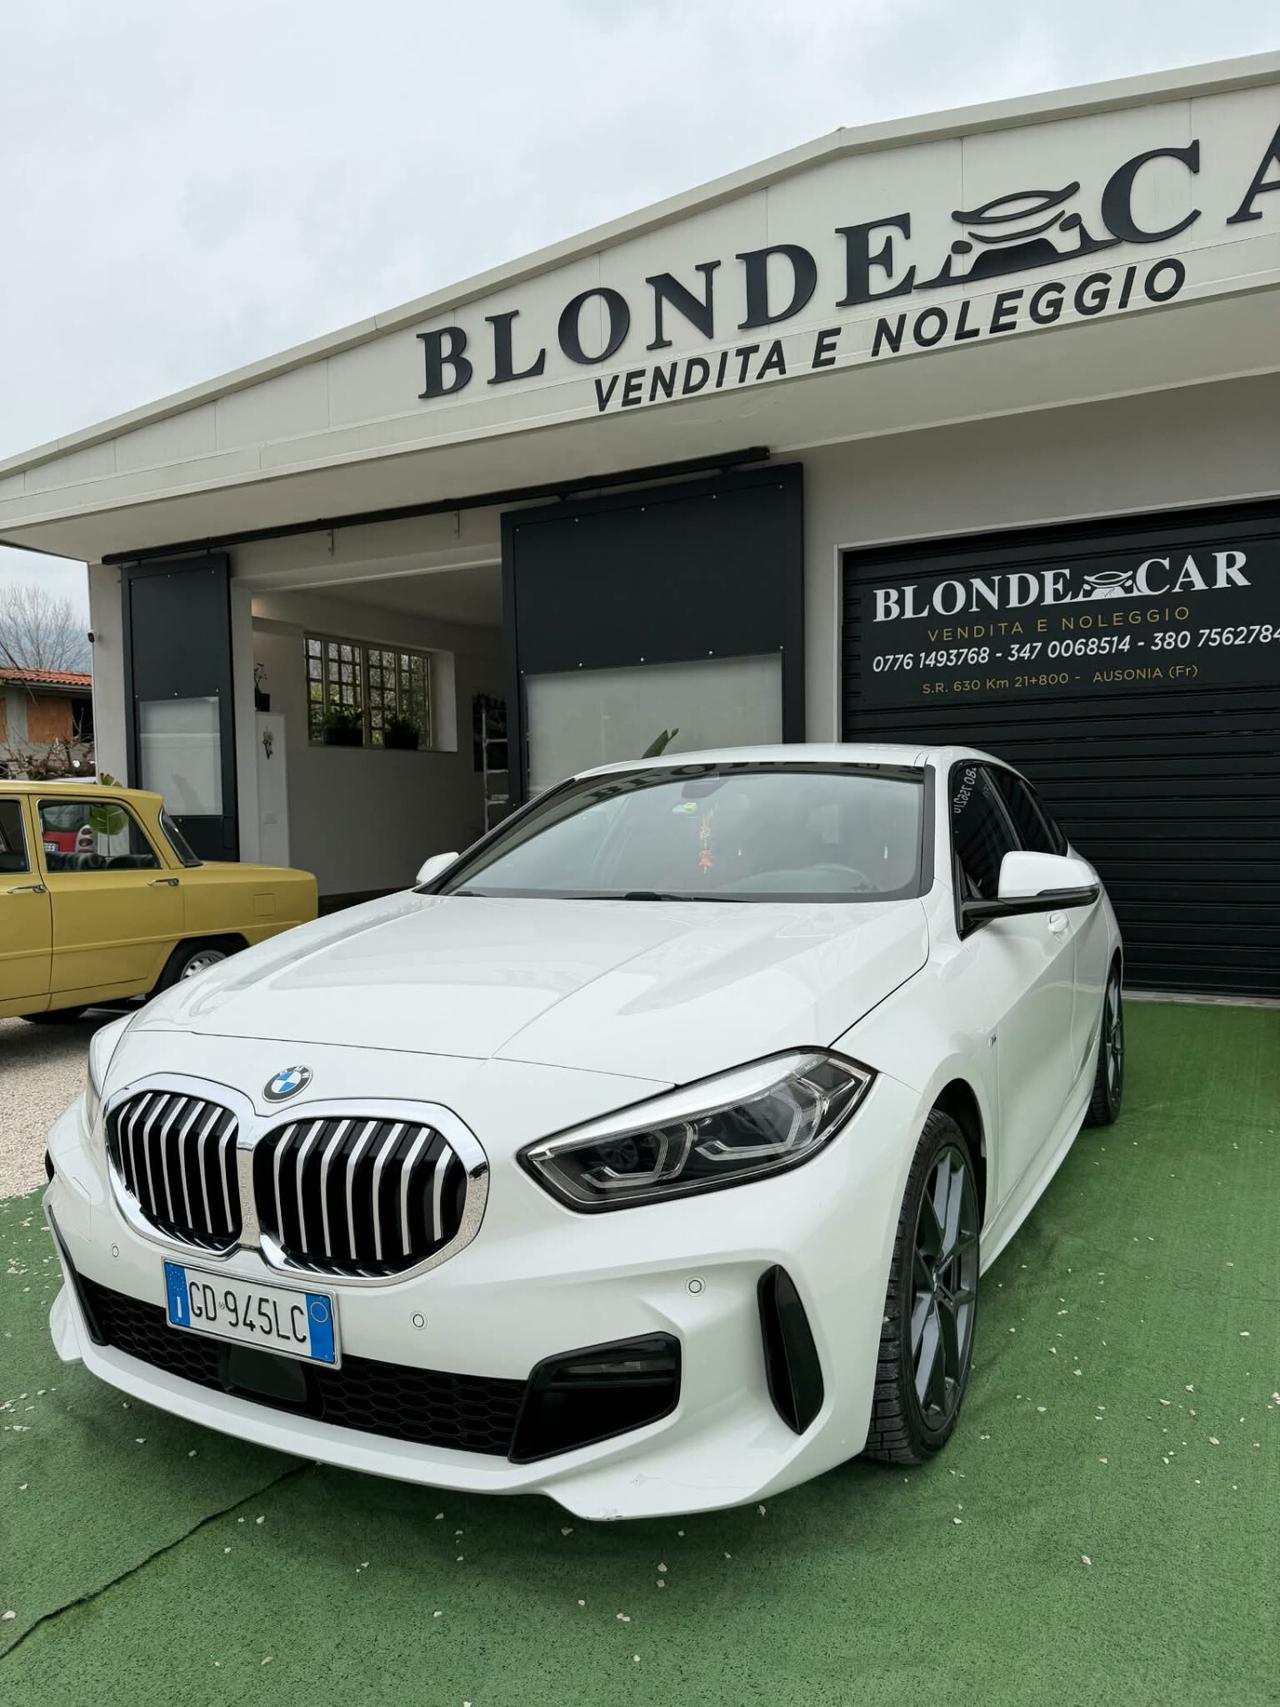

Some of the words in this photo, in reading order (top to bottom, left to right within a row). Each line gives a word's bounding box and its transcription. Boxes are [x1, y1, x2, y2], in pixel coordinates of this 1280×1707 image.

[416, 212, 917, 399] BLONDE
[595, 340, 786, 411] VENDITA
[812, 327, 842, 368] E
[872, 259, 1186, 357] NOLEGGIO
[873, 569, 1072, 623] BLONDE
[1135, 551, 1251, 597] CAR
[873, 652, 913, 673] 0776
[919, 647, 989, 669] 1493768
[1008, 642, 1042, 662] 347
[1048, 635, 1130, 659] 0068514
[1151, 631, 1191, 651] 380
[928, 622, 1024, 642] VENDITA
[1037, 619, 1048, 632] E
[1062, 606, 1190, 631] NOLEGGIO
[922, 683, 949, 694] S.R.
[953, 679, 981, 692] 630
[986, 677, 1009, 689] Km
[1015, 672, 1069, 688] 21+800
[1093, 667, 1163, 683] AUSONIA
[1169, 664, 1199, 679] (Fr)
[188, 1281, 218, 1322] GD
[223, 1290, 308, 1344] 945LC
